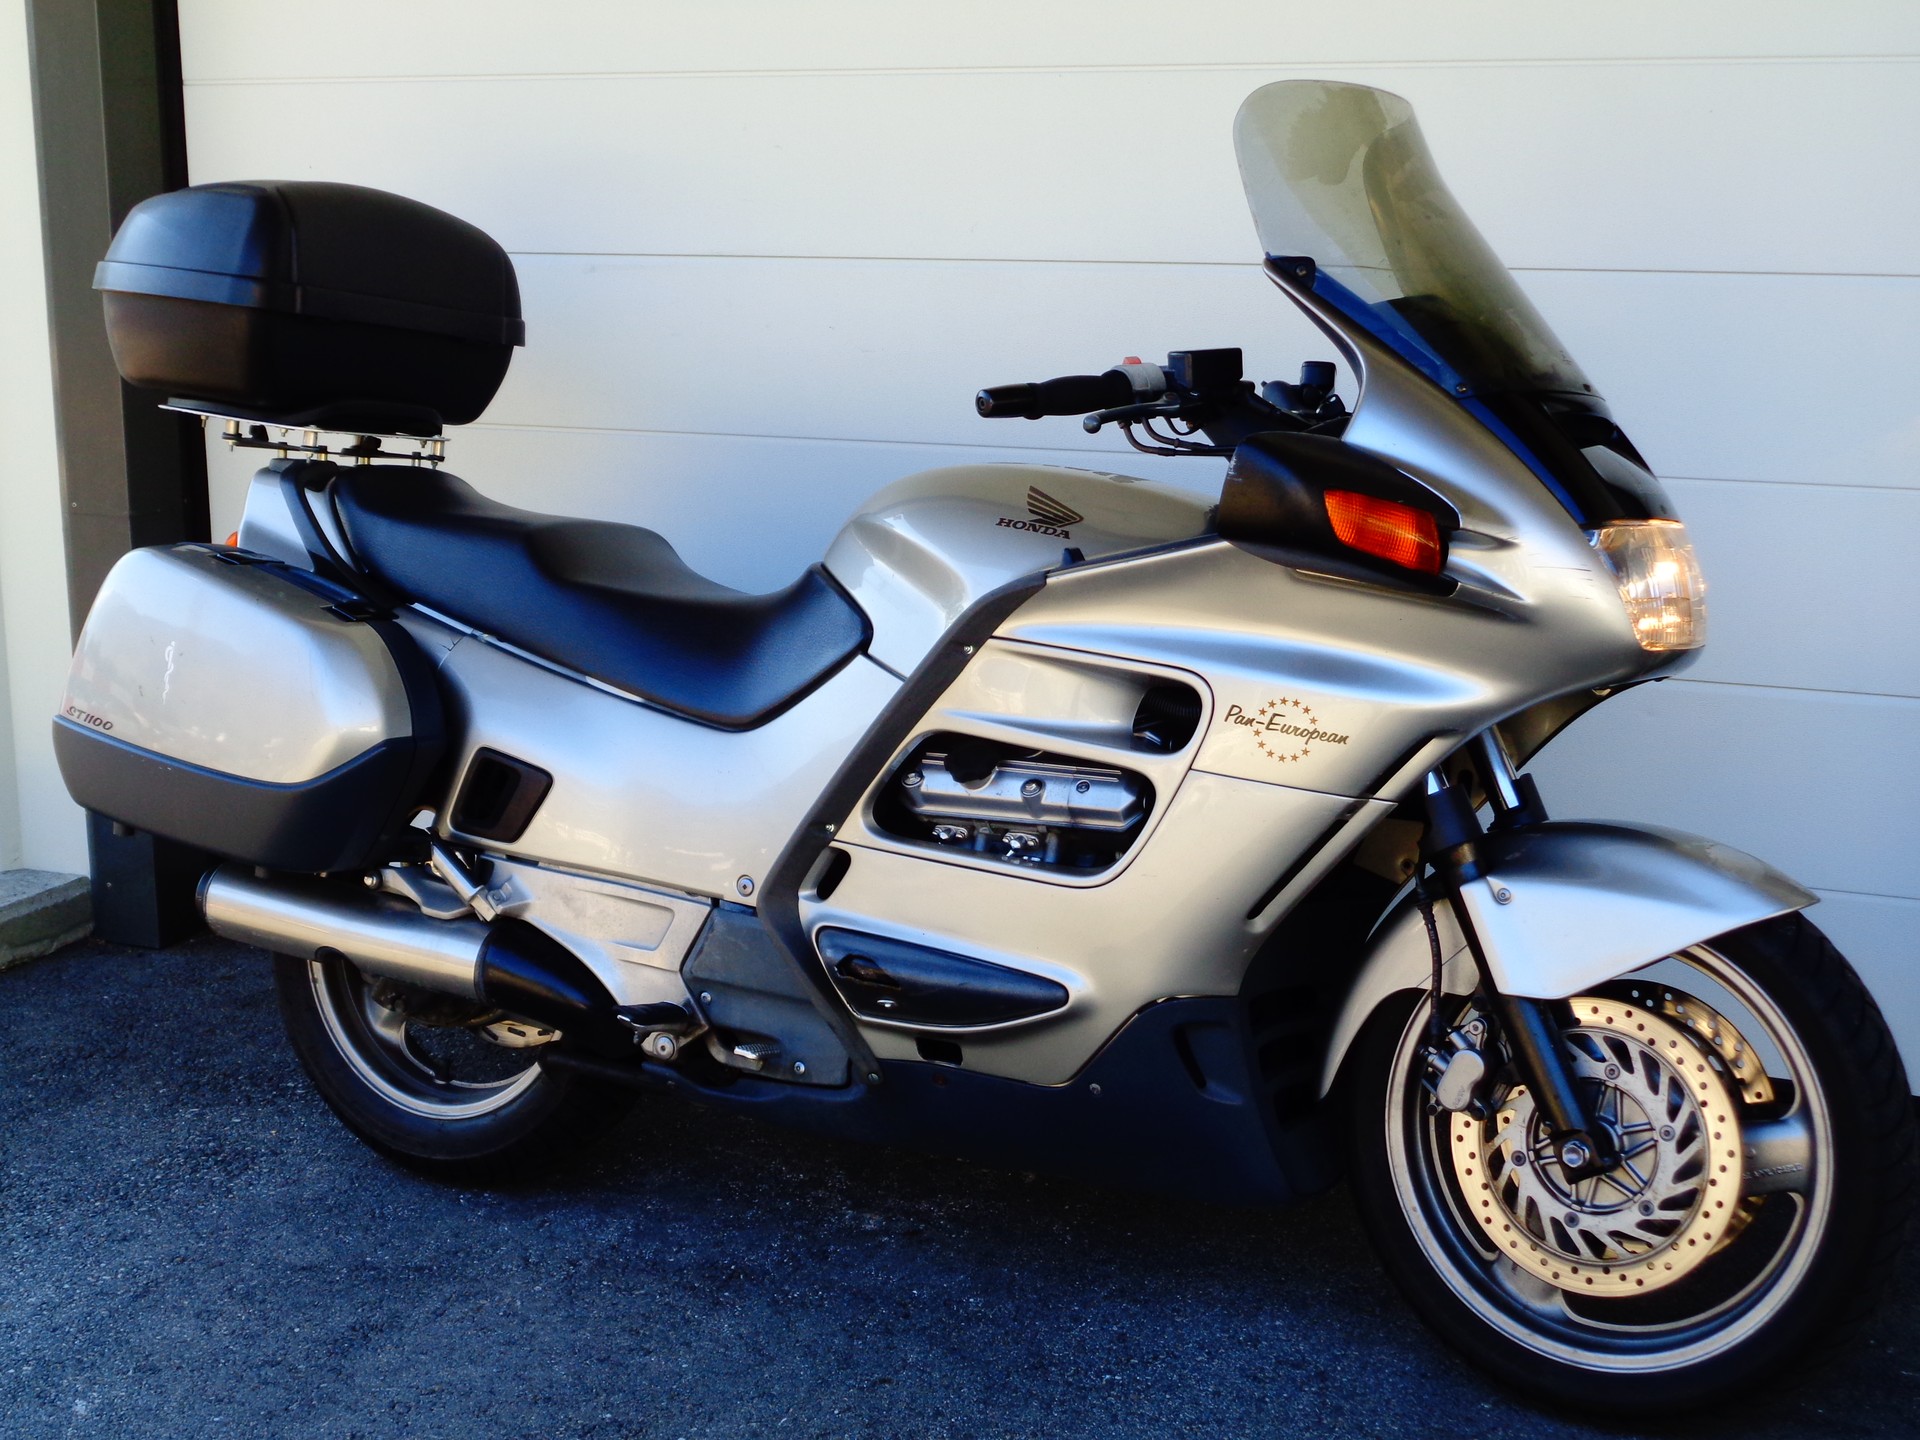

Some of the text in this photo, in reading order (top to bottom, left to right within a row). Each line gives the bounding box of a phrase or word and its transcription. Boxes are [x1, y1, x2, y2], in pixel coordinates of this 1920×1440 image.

[995, 517, 1071, 540] HONDA
[66, 705, 114, 731] ST1100
[1224, 704, 1349, 745] Pan-European
